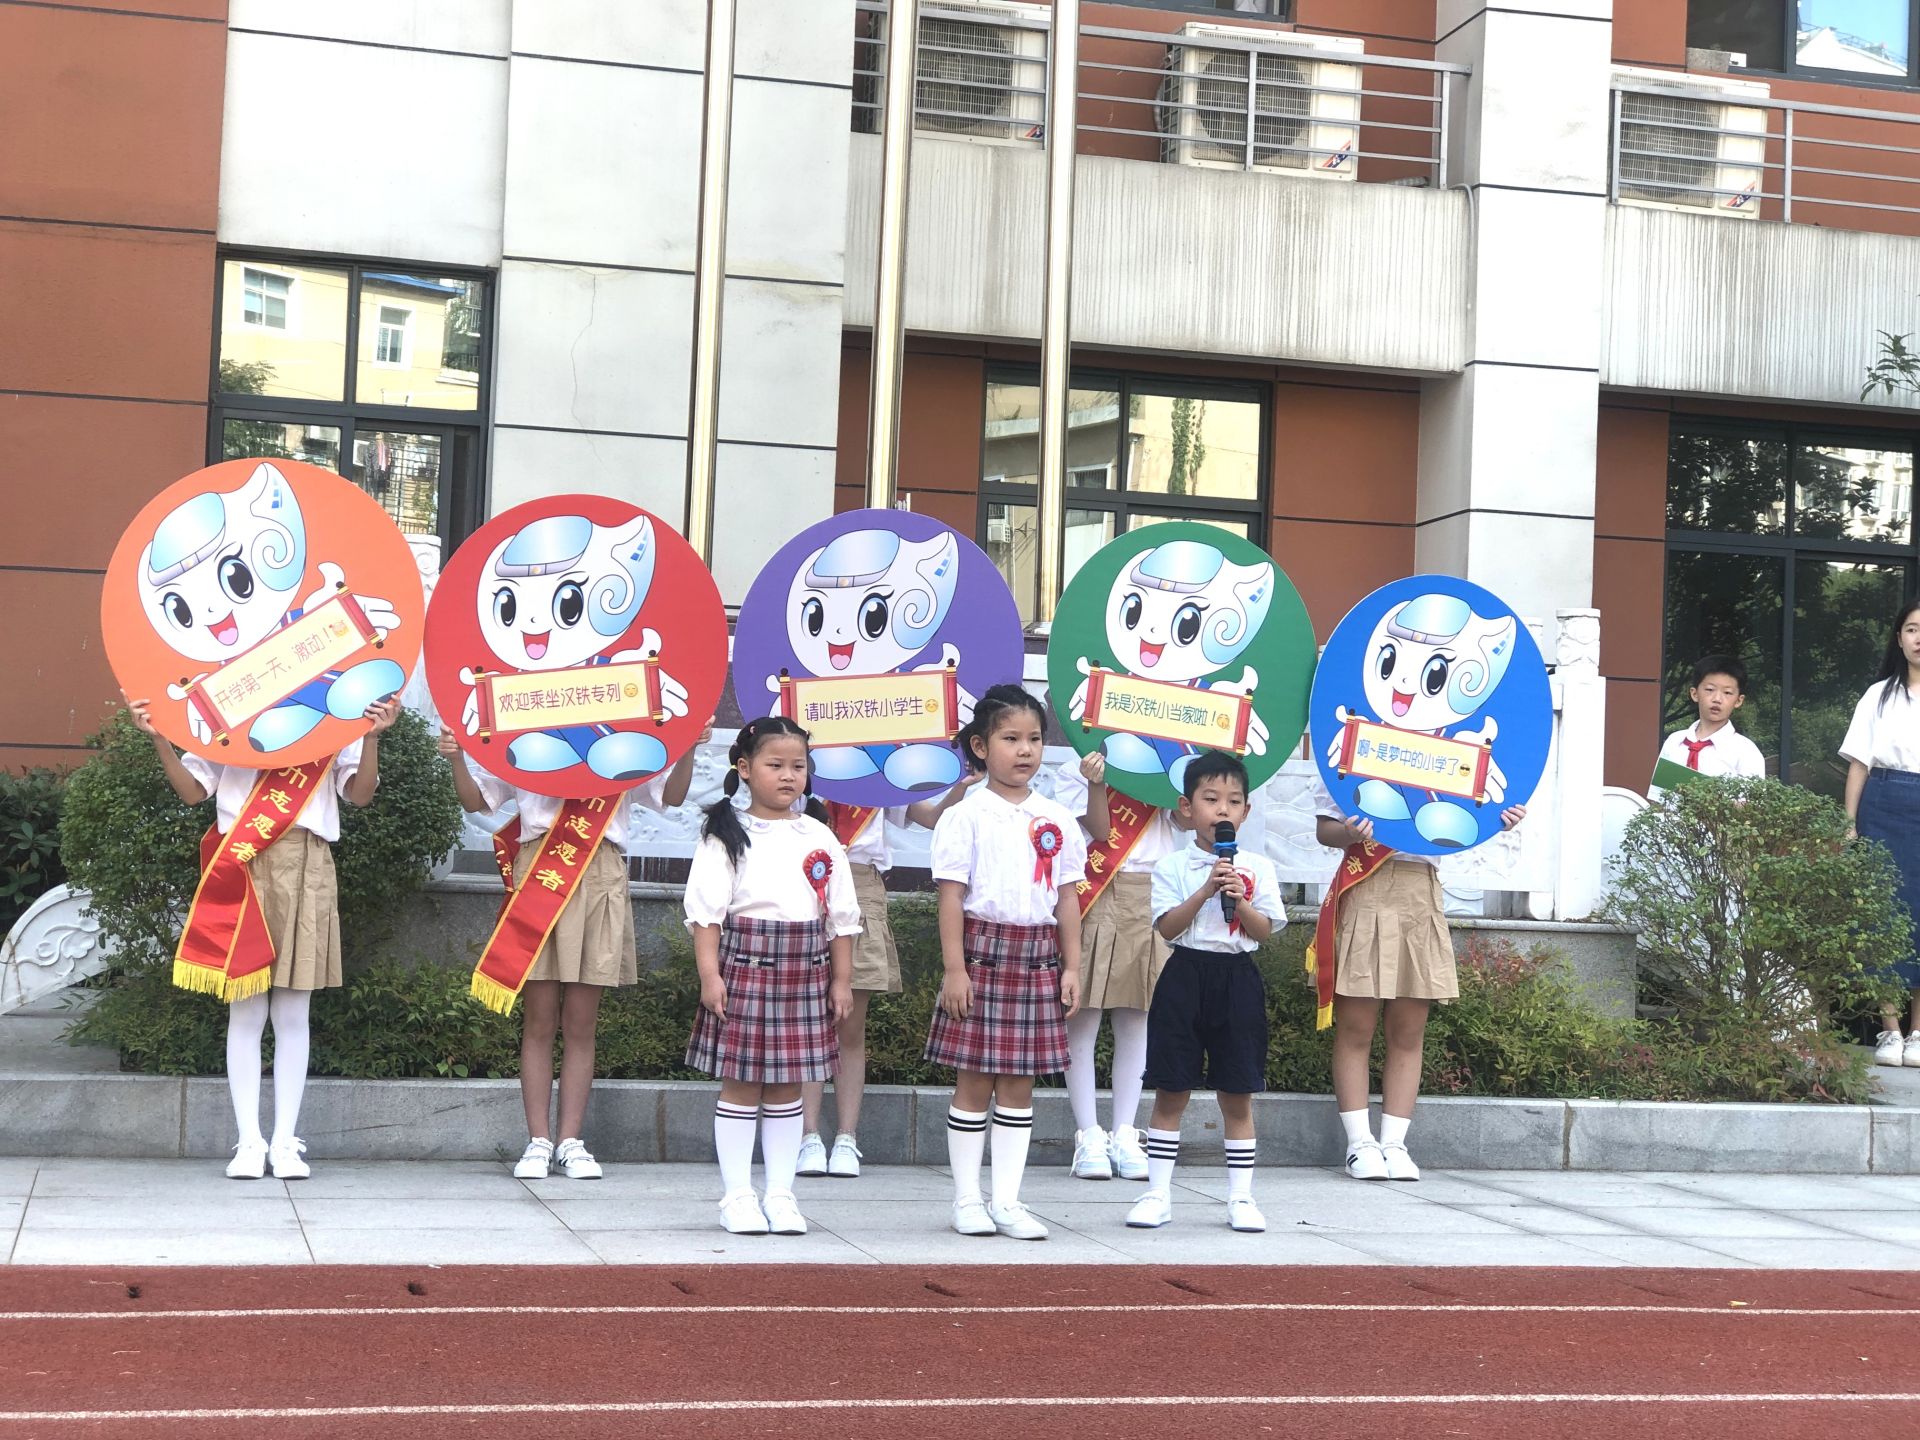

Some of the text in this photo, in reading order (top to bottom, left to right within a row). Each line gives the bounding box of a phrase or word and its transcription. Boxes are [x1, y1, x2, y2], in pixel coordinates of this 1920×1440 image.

[499, 682, 621, 713] 欢迎乘坐汉铁专列
[804, 696, 924, 722] 请叫我汉铁小学生
